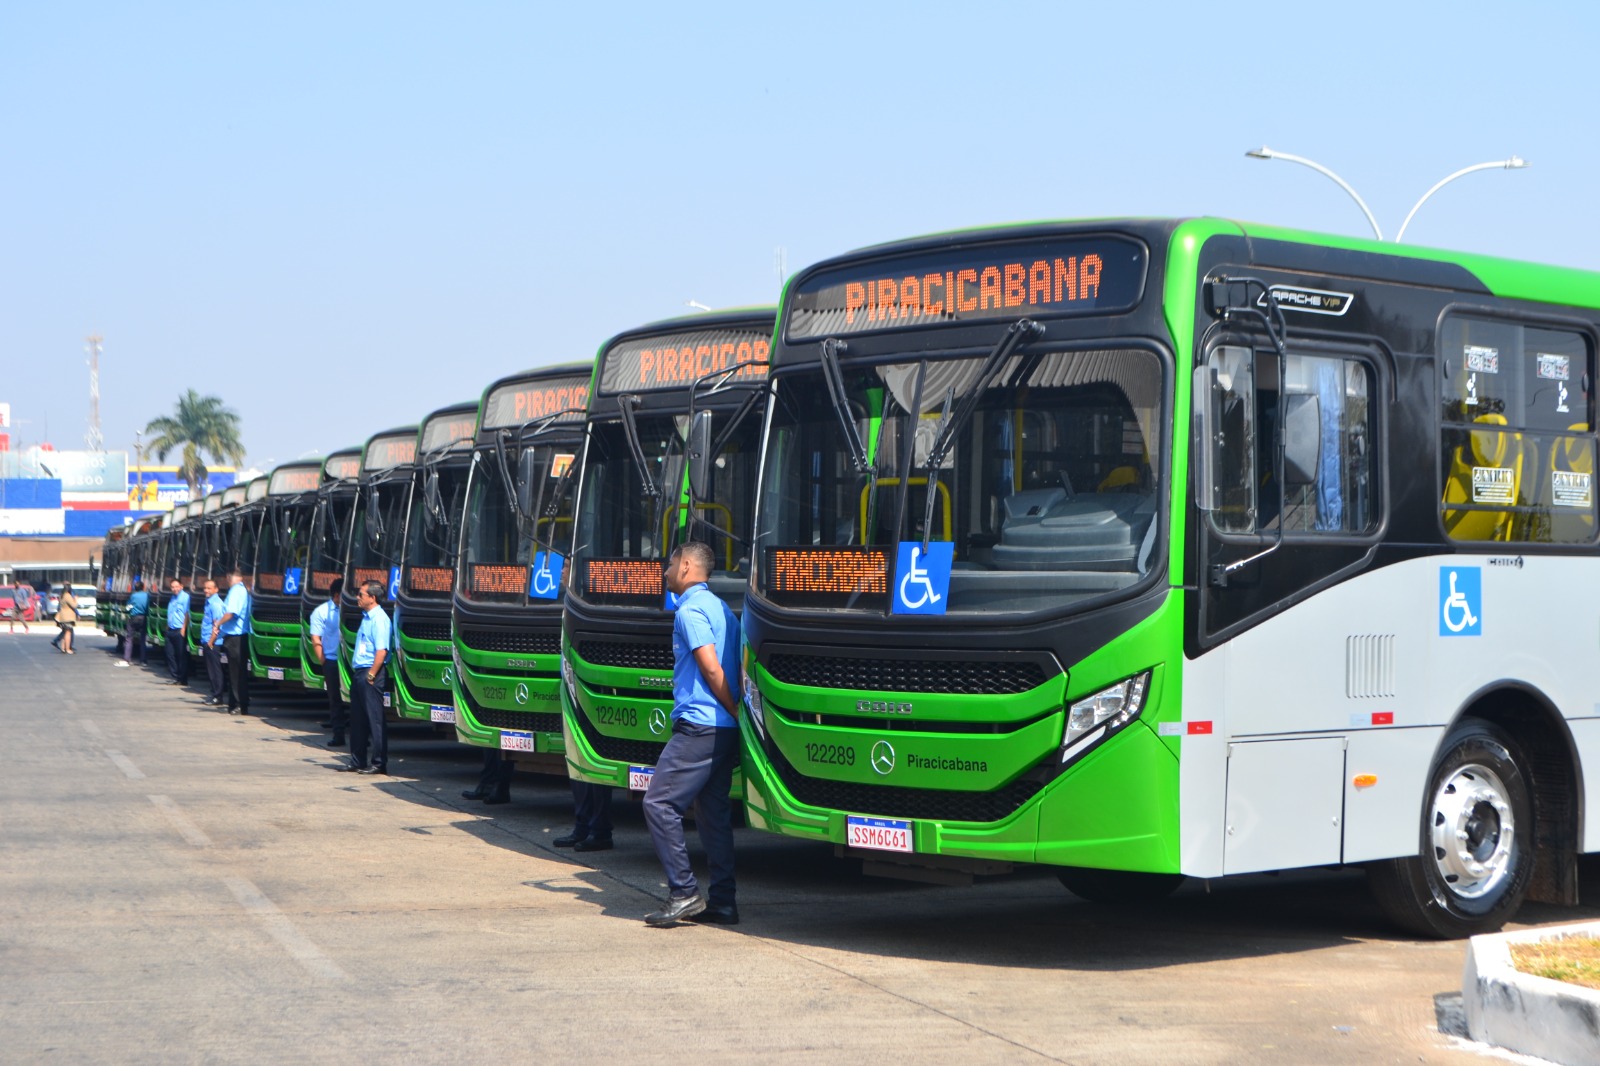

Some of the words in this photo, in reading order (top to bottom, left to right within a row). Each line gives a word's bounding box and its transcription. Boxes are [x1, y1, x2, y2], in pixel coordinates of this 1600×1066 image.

[846, 253, 1102, 324] PIRACICABANA
[1272, 291, 1321, 306] APACHE
[1322, 298, 1340, 308] VIP
[515, 386, 591, 419] PIRACIC
[775, 551, 887, 593] PIRACICABANA
[595, 706, 638, 728] 122408
[804, 741, 856, 767] 122289
[906, 753, 988, 773] Piracicabana
[853, 826, 908, 849] SSM6C61
